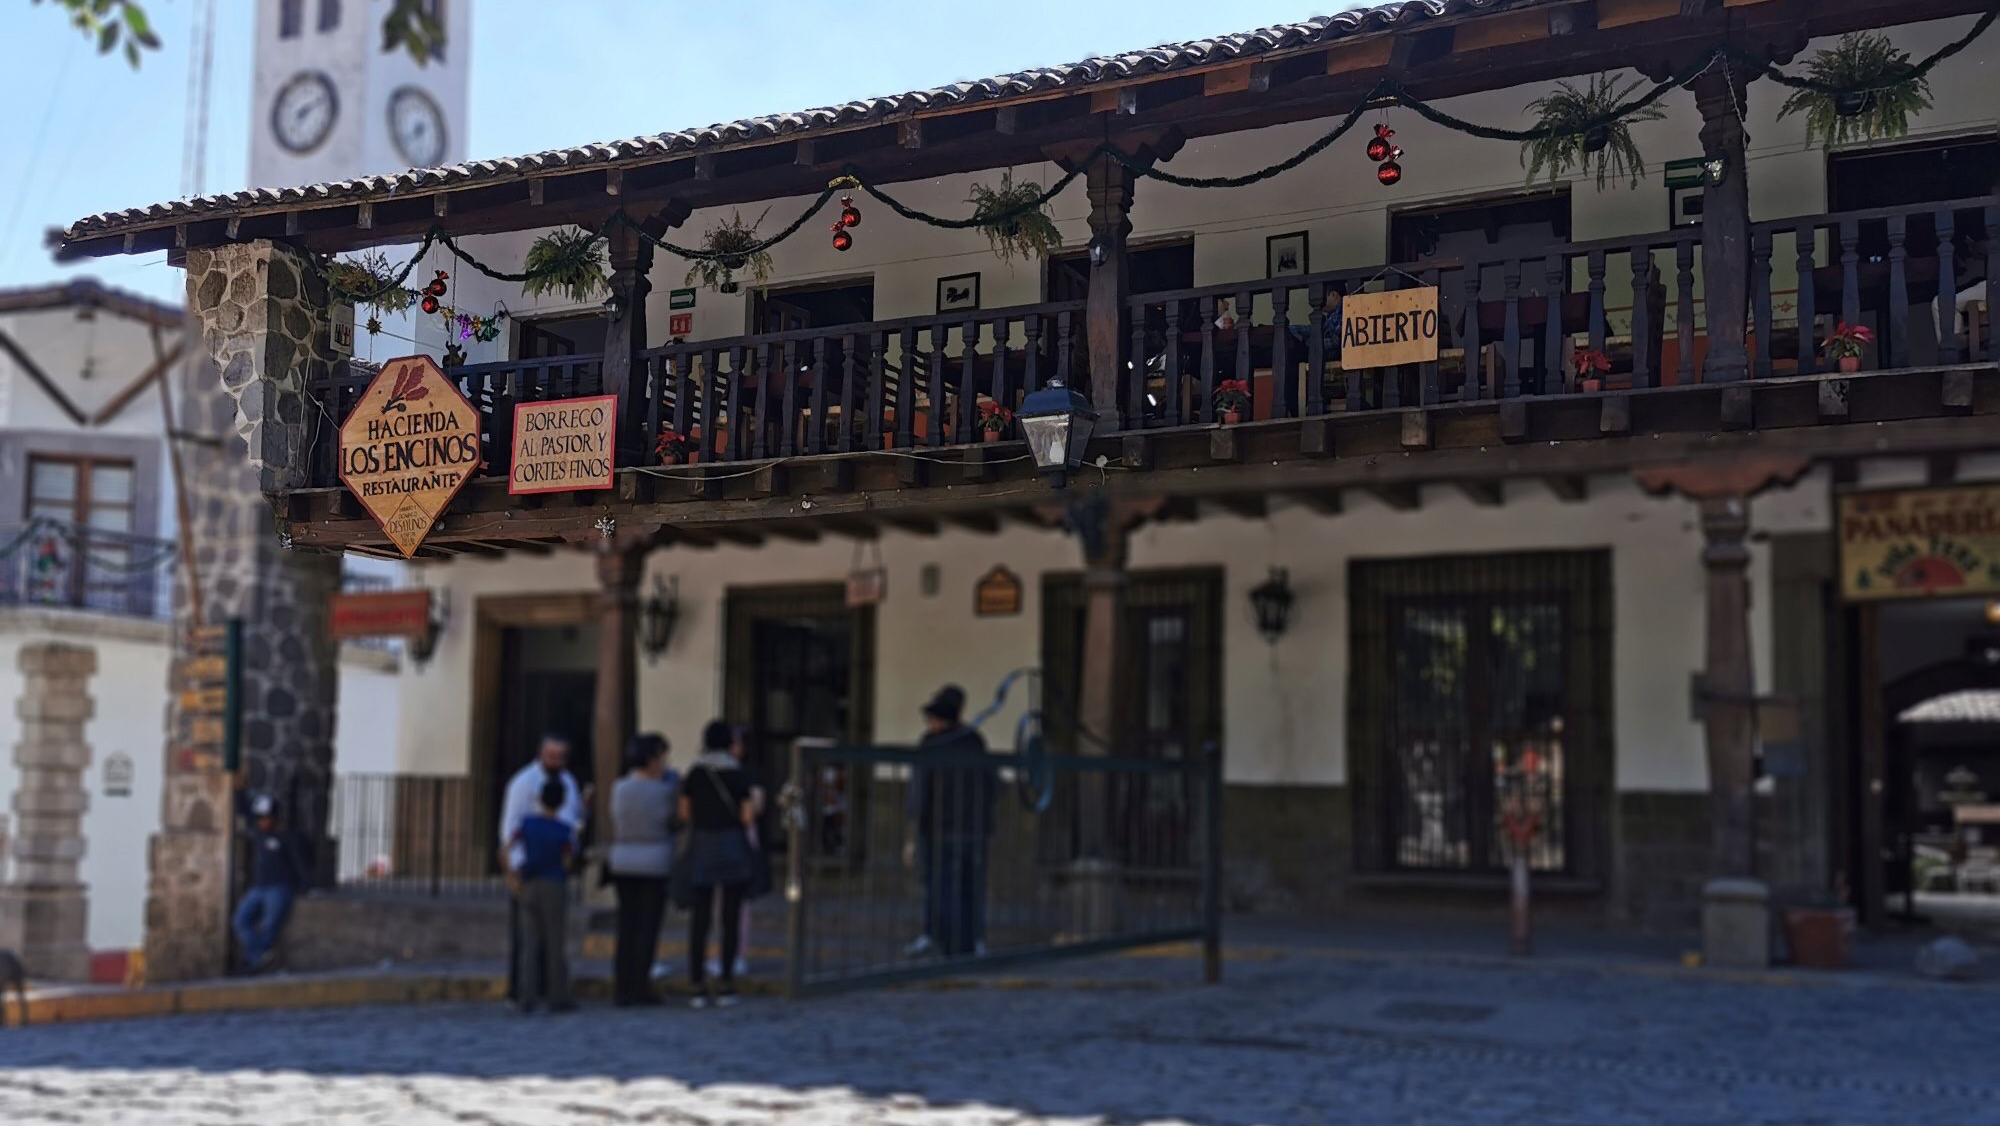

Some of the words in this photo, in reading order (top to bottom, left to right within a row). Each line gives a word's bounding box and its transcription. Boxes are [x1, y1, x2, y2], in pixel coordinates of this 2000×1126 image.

[1343, 309, 1437, 348] ABIERTO
[368, 410, 460, 441] HACIENDA
[525, 407, 605, 432] BORREGO
[342, 446, 380, 477] LOS
[383, 433, 478, 473] ENCINOS
[521, 440, 538, 458] AL
[541, 435, 592, 455] PASTOR
[597, 432, 608, 452] Y
[514, 460, 568, 483] CORTES
[570, 457, 611, 480] FINOS
[362, 473, 458, 497] RESTAURANTE
[1844, 509, 2000, 543] PANADERI
